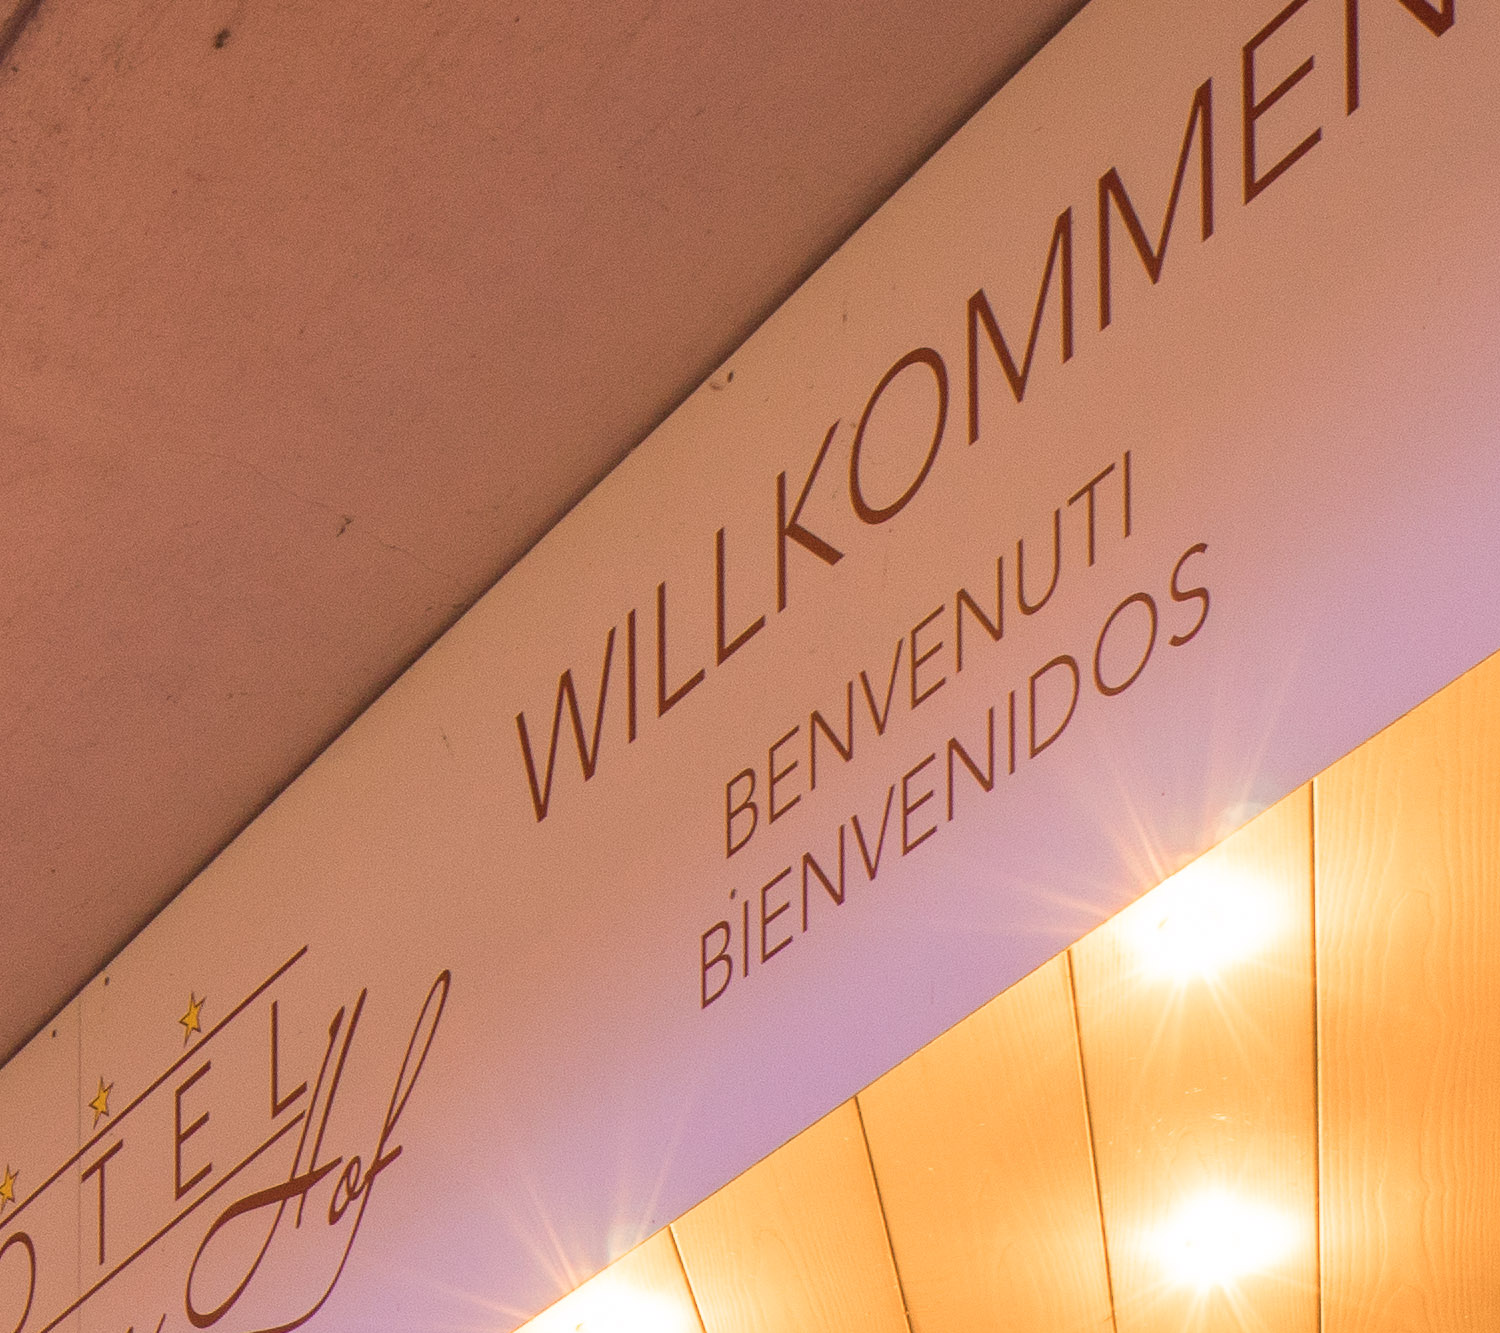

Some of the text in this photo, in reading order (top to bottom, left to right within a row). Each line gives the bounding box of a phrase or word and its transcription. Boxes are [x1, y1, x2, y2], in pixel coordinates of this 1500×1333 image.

[699, 541, 1212, 1011] BIENVENIDOS
[723, 449, 1134, 860] BENVENUTI
[185, 968, 452, 1332] Hof
